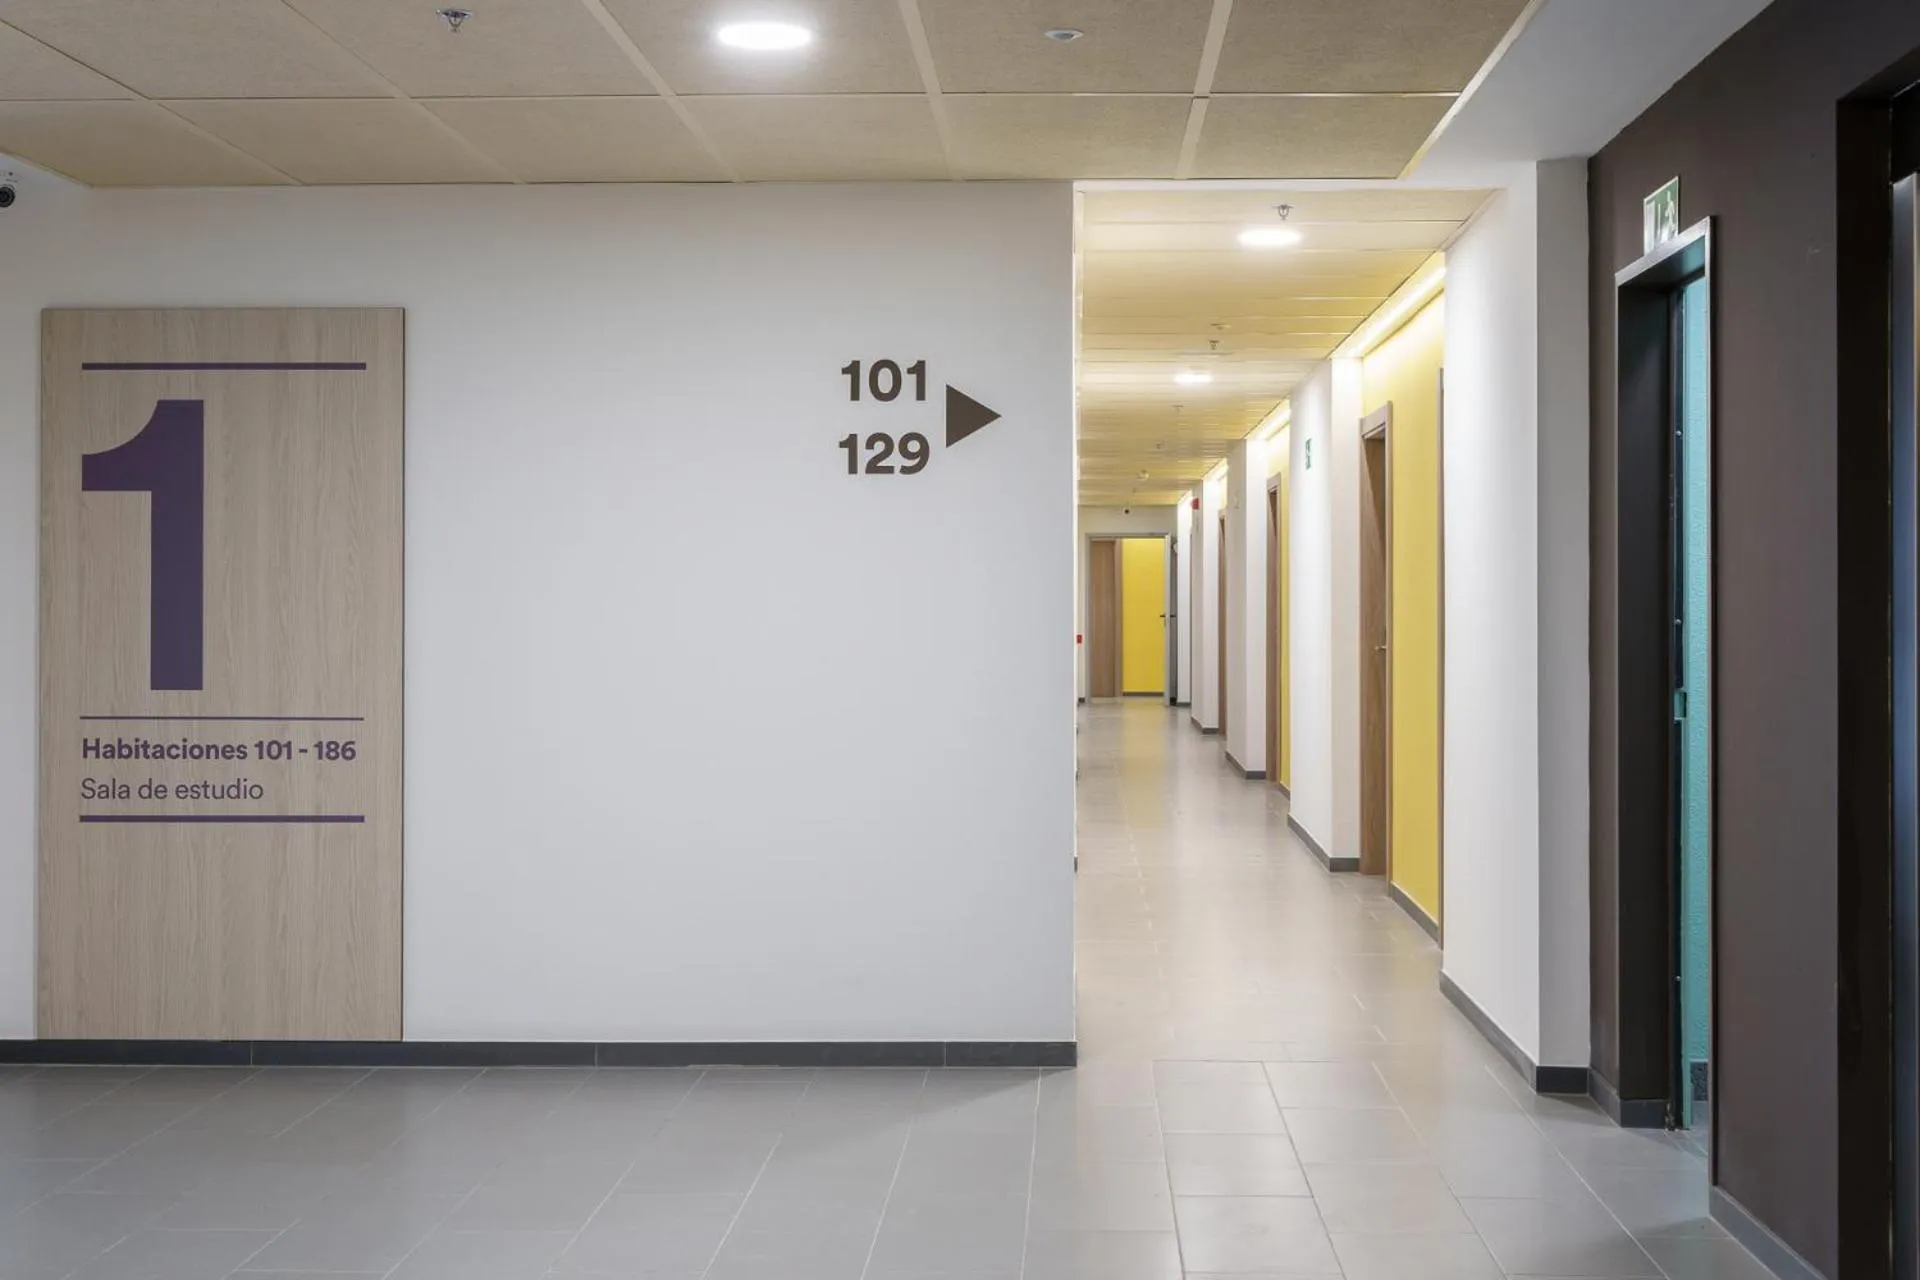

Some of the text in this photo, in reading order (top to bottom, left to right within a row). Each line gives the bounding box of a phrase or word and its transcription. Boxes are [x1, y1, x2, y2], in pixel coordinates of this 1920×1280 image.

[841, 359, 926, 402] 101
[838, 432, 930, 475] 129
[81, 399, 204, 690] 1
[82, 736, 248, 761] Habitaciones
[254, 740, 293, 761] 101
[314, 740, 357, 762] 186
[81, 777, 264, 800] Sala de estudio
